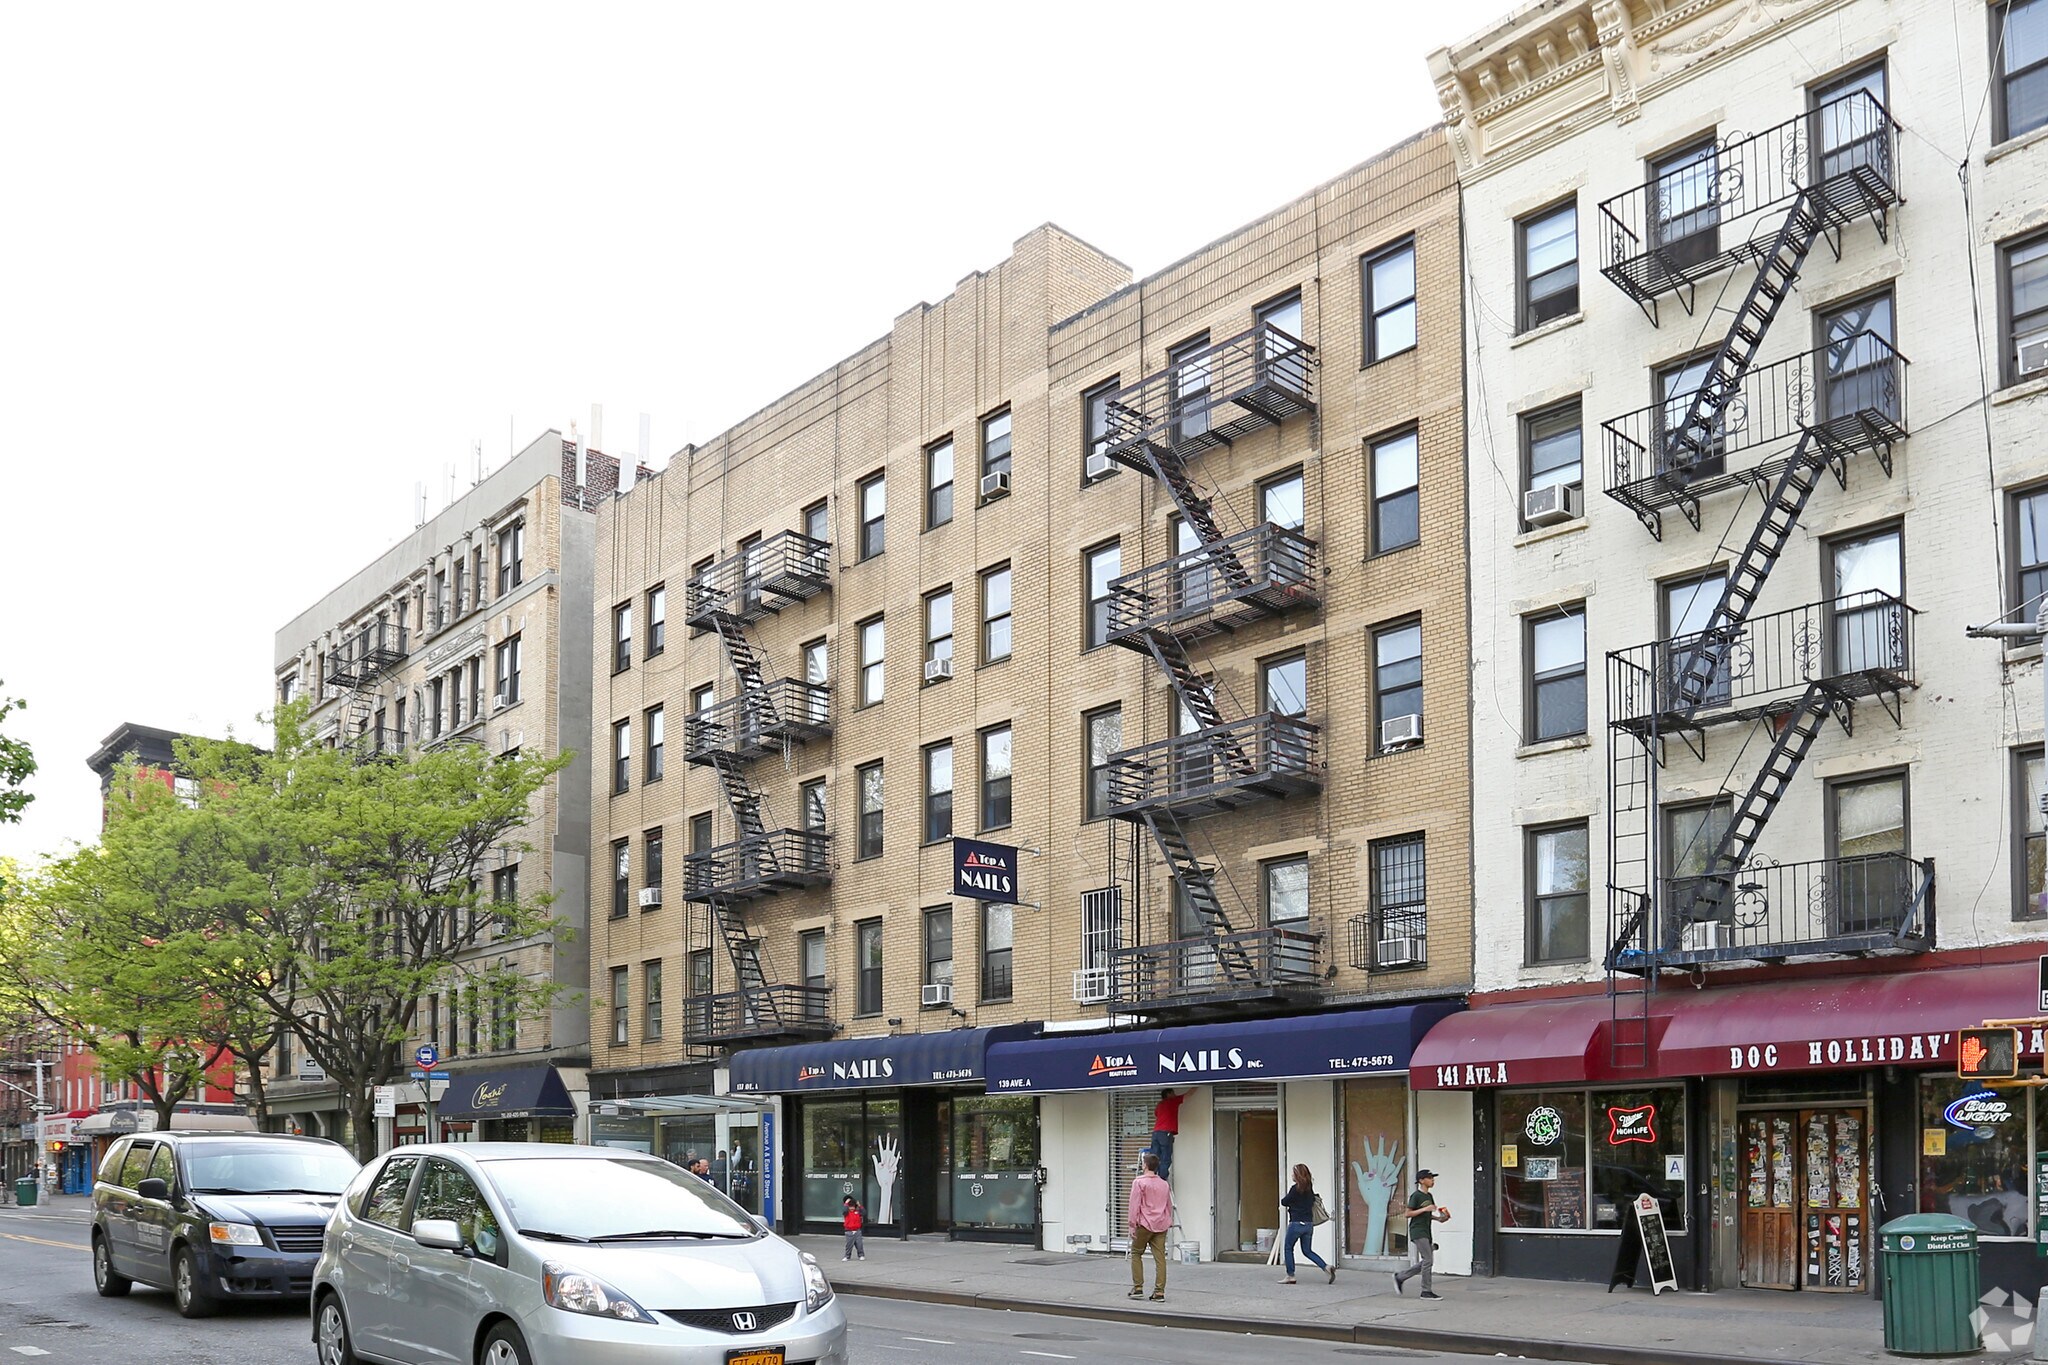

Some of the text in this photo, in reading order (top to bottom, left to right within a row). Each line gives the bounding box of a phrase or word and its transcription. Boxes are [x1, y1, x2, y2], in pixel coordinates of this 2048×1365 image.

[978, 854, 1006, 868] Top A
[960, 869, 1011, 893] NAILS
[1105, 1054, 1134, 1067] Top A
[1159, 1048, 1264, 1074] NAILS INC.
[1329, 1055, 1394, 1069] TEL: 475-5678
[1730, 1044, 1777, 1069] DOC
[833, 1058, 893, 1080] NAILS
[998, 1078, 1032, 1088] 139 AVE. A
[1436, 1066, 1459, 1087] 141
[1964, 1100, 2007, 1112] BUD
[1954, 1111, 2012, 1122] LIGHT
[1633, 1126, 1649, 1134] LIFE
[1669, 1160, 1681, 1174] A
[1930, 1234, 1968, 1244] Keep Council
